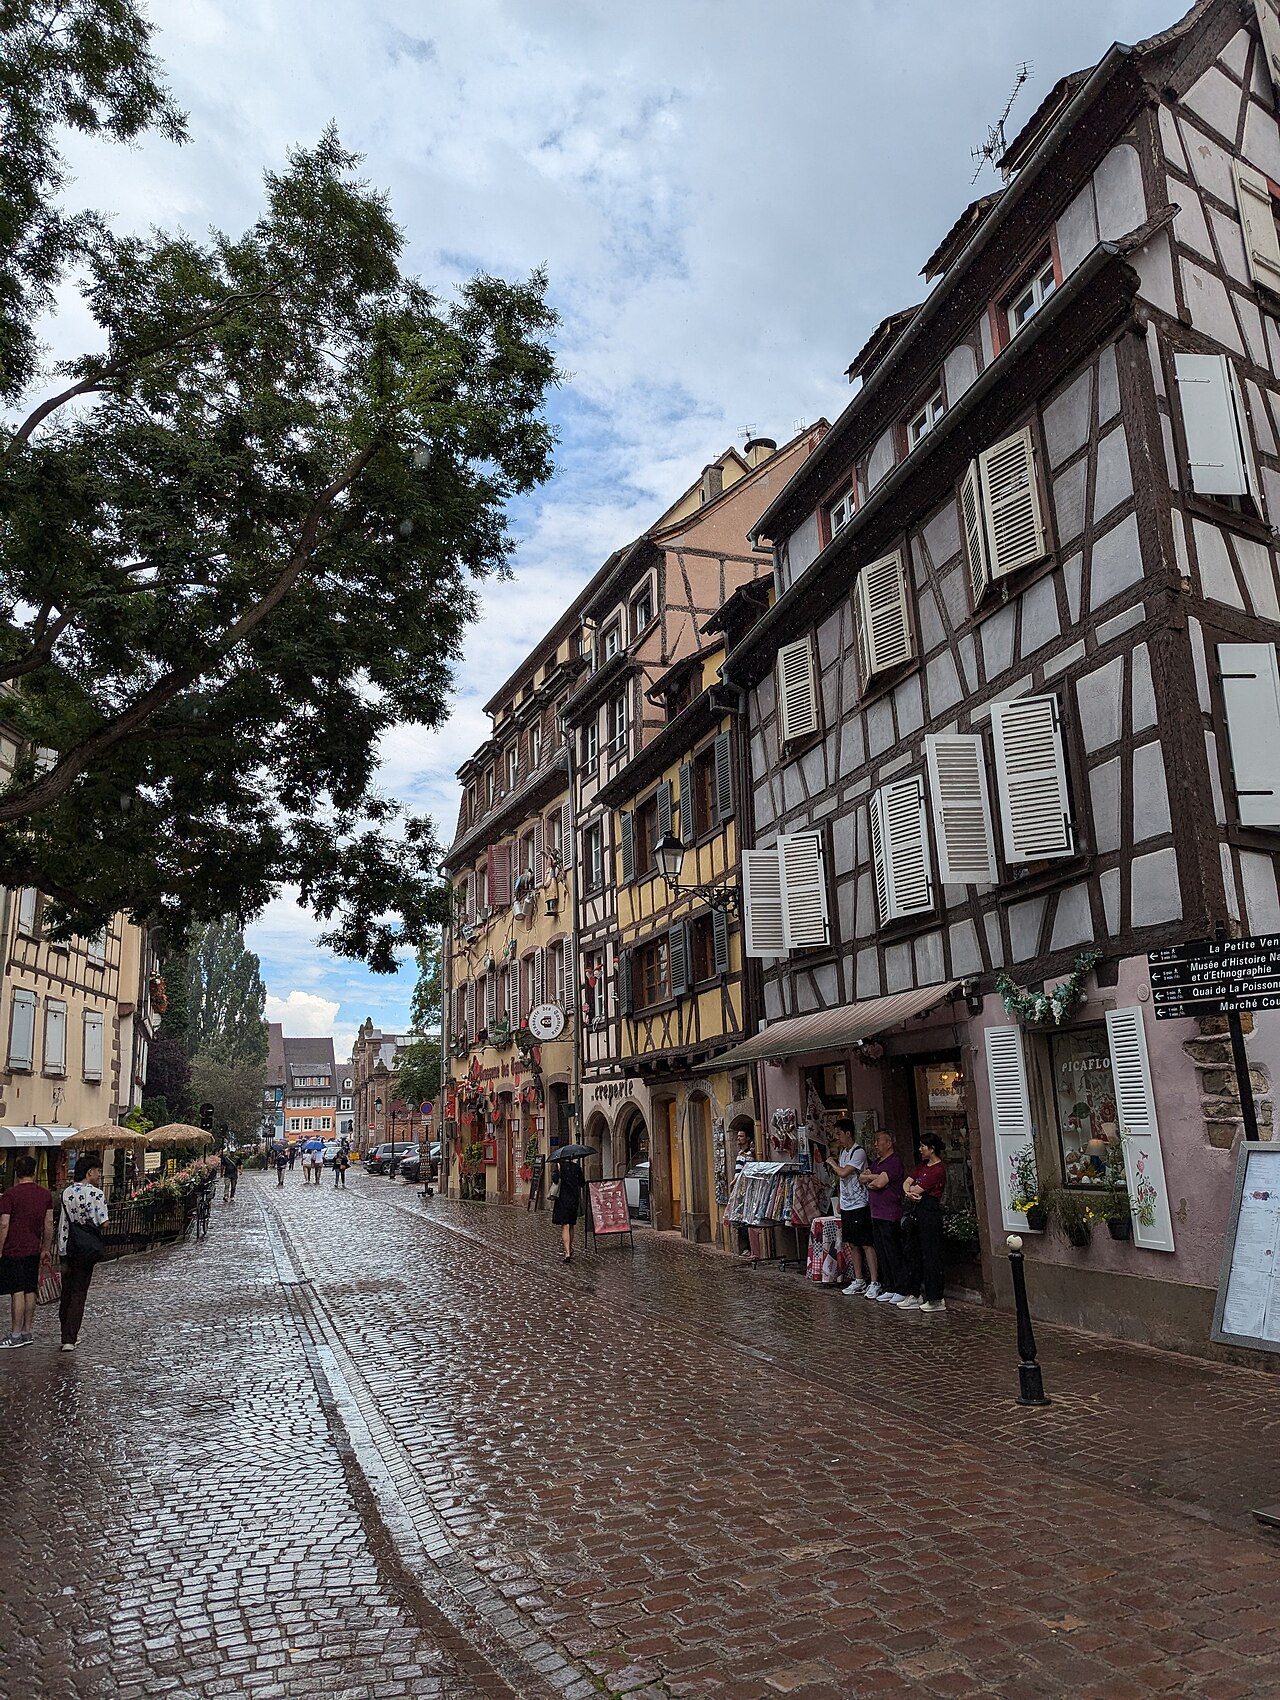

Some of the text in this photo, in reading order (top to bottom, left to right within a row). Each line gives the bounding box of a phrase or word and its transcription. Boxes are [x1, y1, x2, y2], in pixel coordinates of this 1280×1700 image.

[1209, 938, 1279, 953] La Petite Ven
[1190, 960, 1219, 971] Musée
[1222, 955, 1266, 967] d'Histoire
[1191, 965, 1272, 982] et d'Ethnographie
[1192, 981, 1280, 997] Quai de La Poisson
[1219, 999, 1257, 1011] Marché
[1062, 1057, 1110, 1072] PICAFLO
